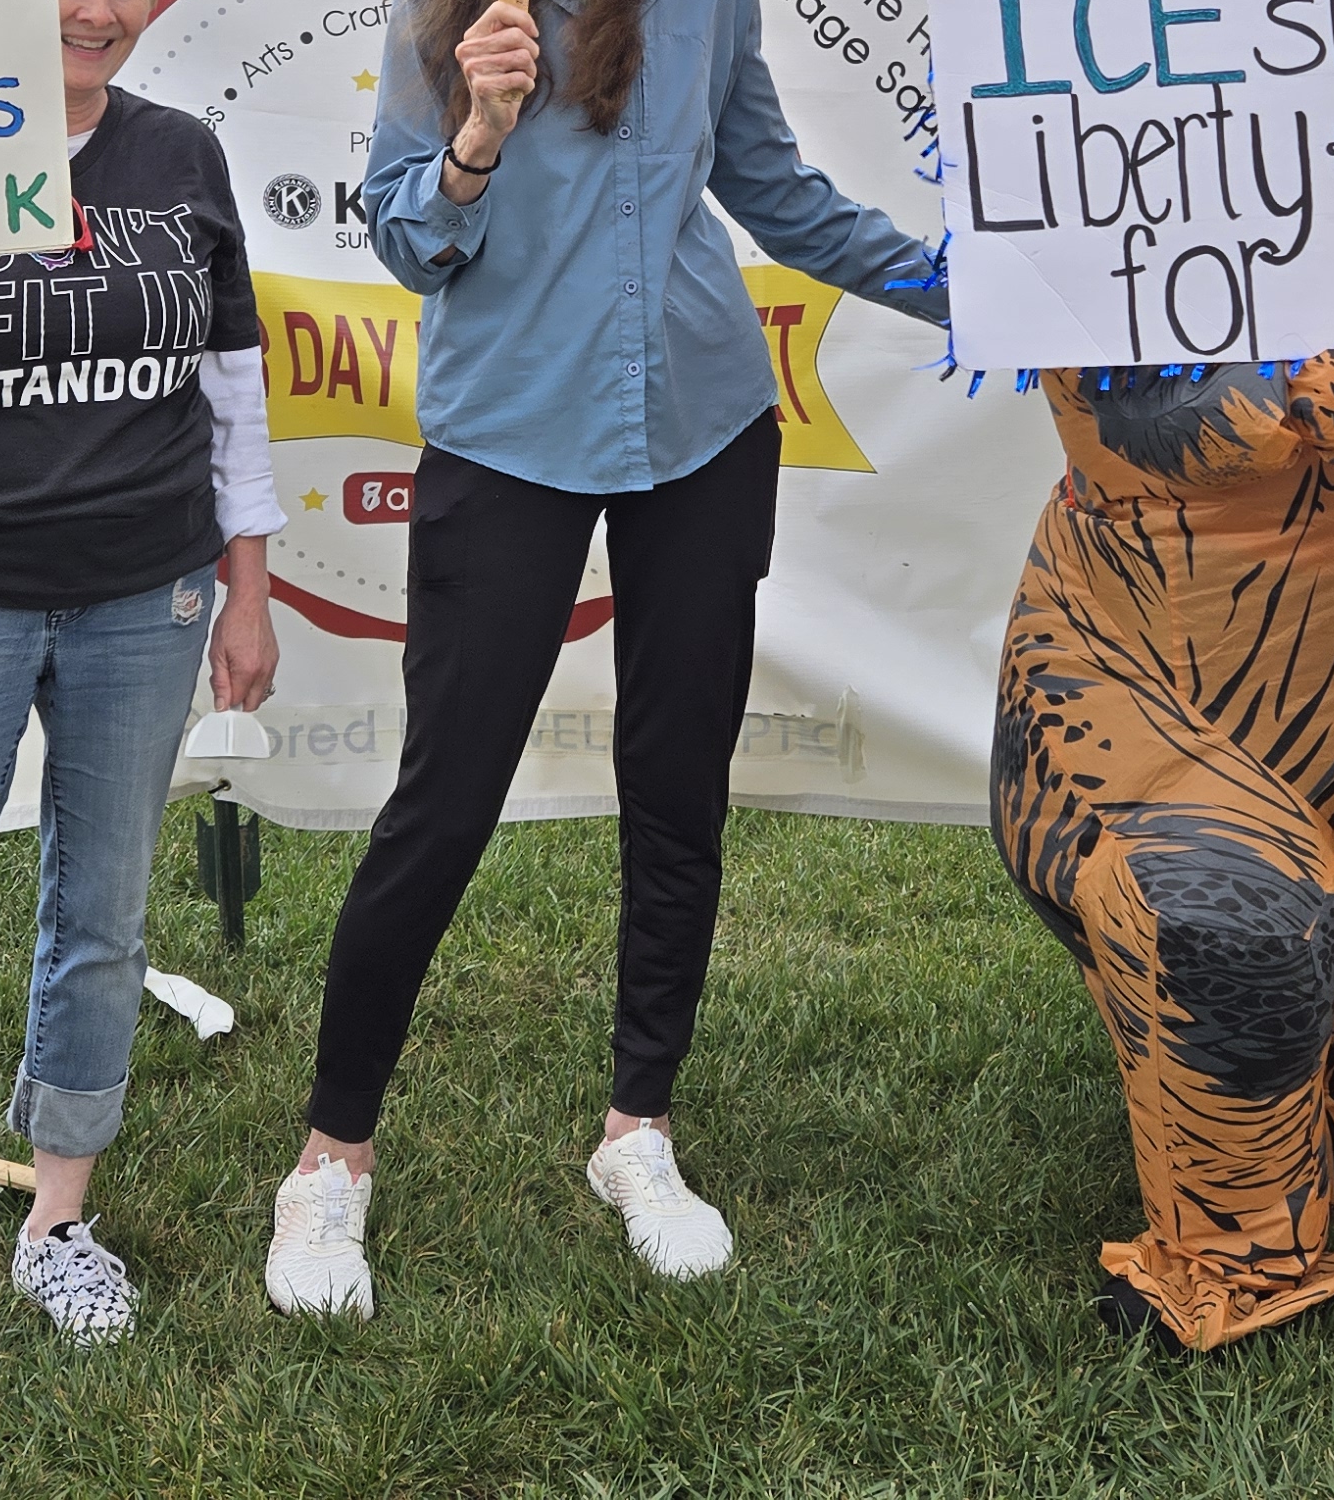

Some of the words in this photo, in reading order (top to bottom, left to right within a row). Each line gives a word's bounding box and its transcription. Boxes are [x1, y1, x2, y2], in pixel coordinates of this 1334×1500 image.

[241, 41, 295, 89] Arts
[334, 181, 368, 225] K
[964, 84, 1313, 266] Liberty
[137, 267, 212, 350] IN
[1111, 224, 1279, 363] for
[282, 310, 399, 408] DAY
[754, 303, 812, 426] T
